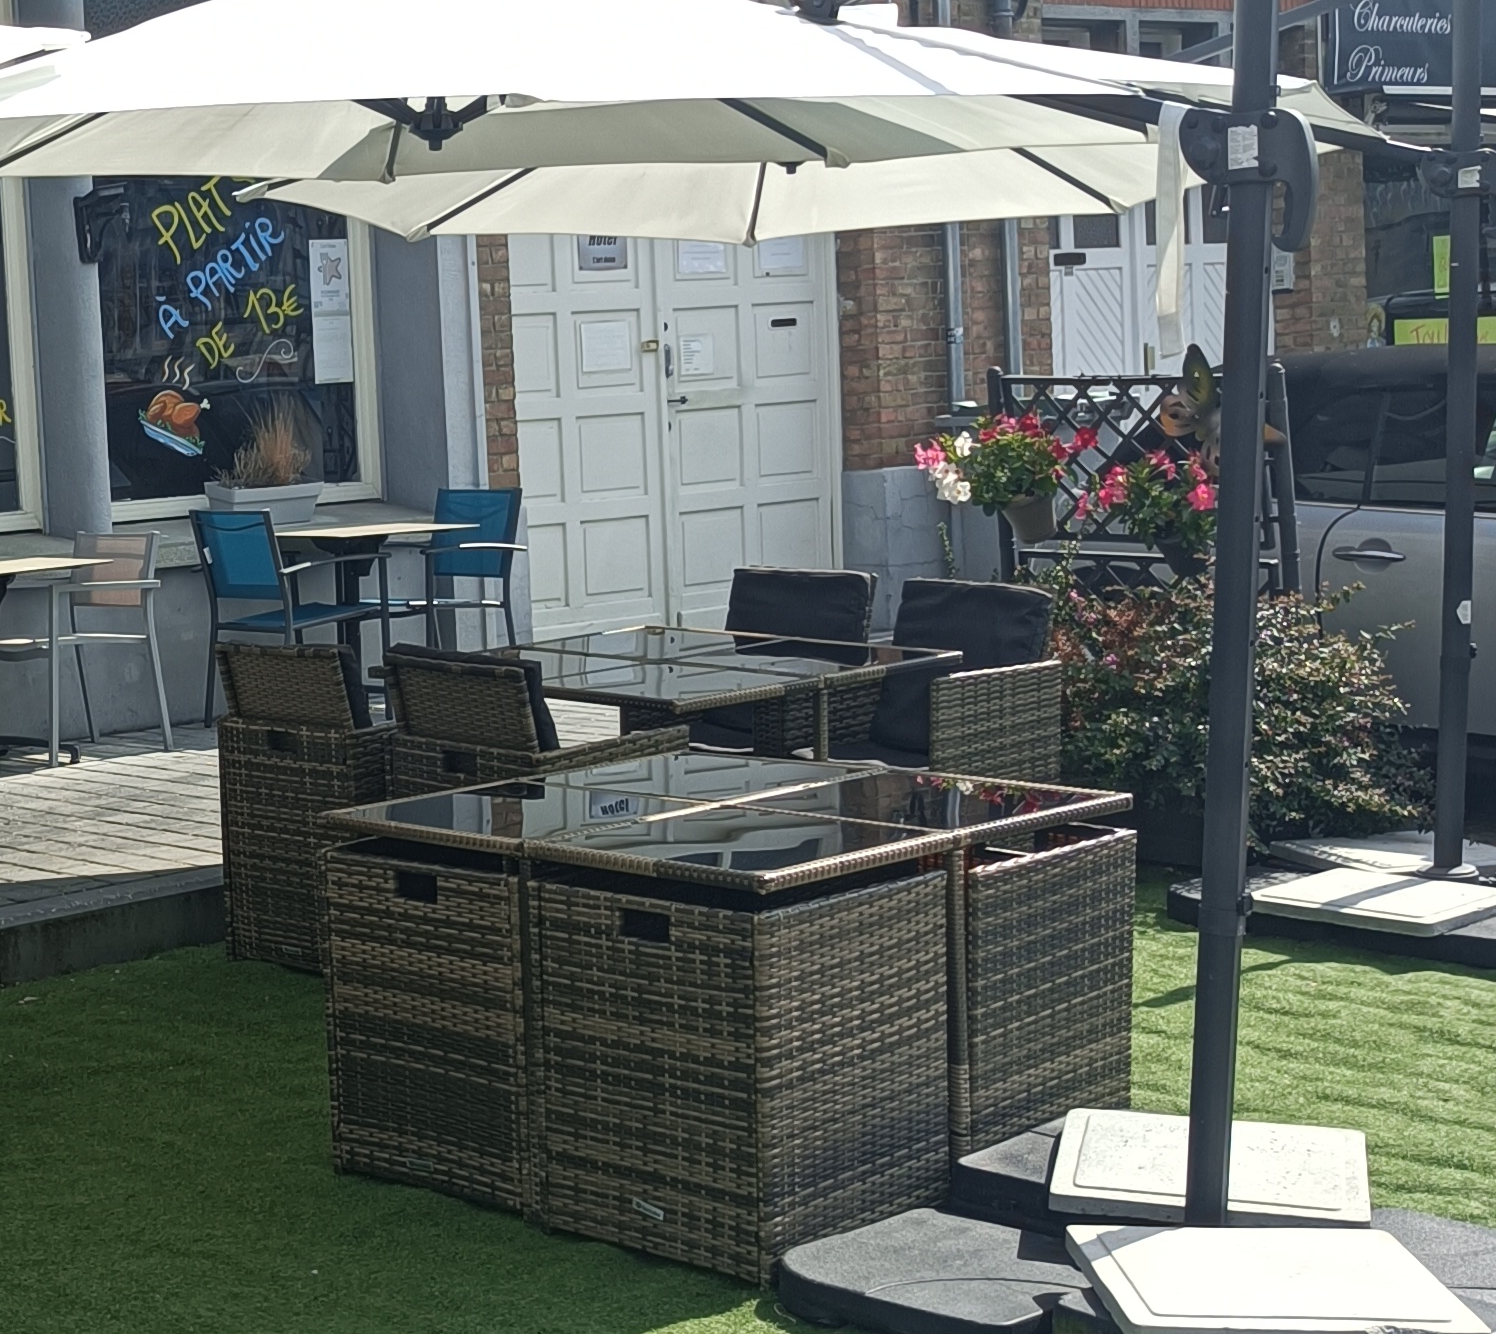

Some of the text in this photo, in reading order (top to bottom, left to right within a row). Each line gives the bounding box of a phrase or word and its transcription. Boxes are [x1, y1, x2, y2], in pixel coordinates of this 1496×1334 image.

[1346, 44, 1429, 83] Primeurs
[152, 176, 255, 265] PLAT
[196, 283, 304, 369] DE 13€
